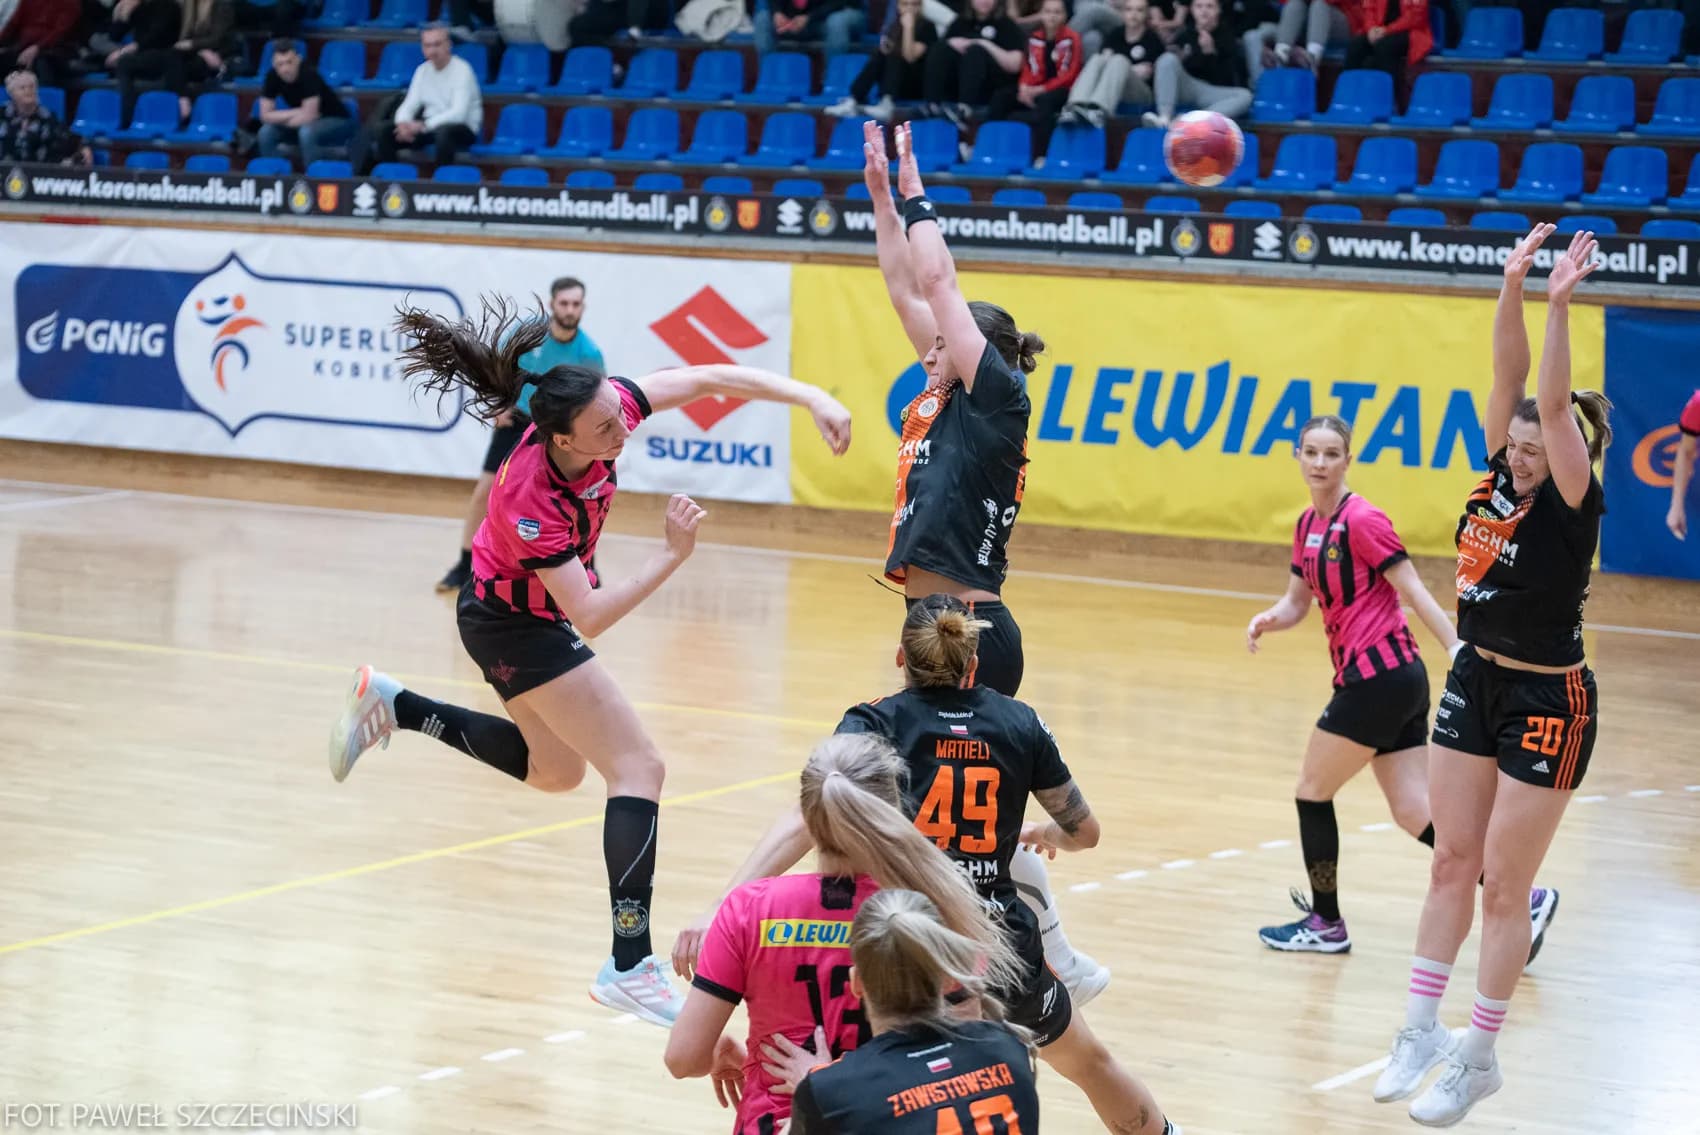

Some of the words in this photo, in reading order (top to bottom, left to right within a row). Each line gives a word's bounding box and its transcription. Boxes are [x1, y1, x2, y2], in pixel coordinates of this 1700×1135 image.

[32, 172, 283, 212] www.koronahandball.pl
[413, 187, 698, 231] www.koronahandball.pl
[844, 210, 1163, 256] wworonahandball.pl
[1327, 231, 1687, 283] www.koronaanball.pl
[62, 318, 166, 357] PGNiG
[284, 322, 422, 354] SUPERLI
[313, 359, 393, 381] KOBIE
[1037, 360, 1489, 472] LEWIATAN
[646, 435, 772, 467] SUZUKI
[1463, 519, 1519, 561] KGHM
[936, 739, 990, 760] MATIELI
[1521, 716, 1566, 757] 20
[913, 765, 1000, 854] 49
[794, 922, 853, 944] LEWI
[886, 1062, 1015, 1118] ZAWISTOWSKA
